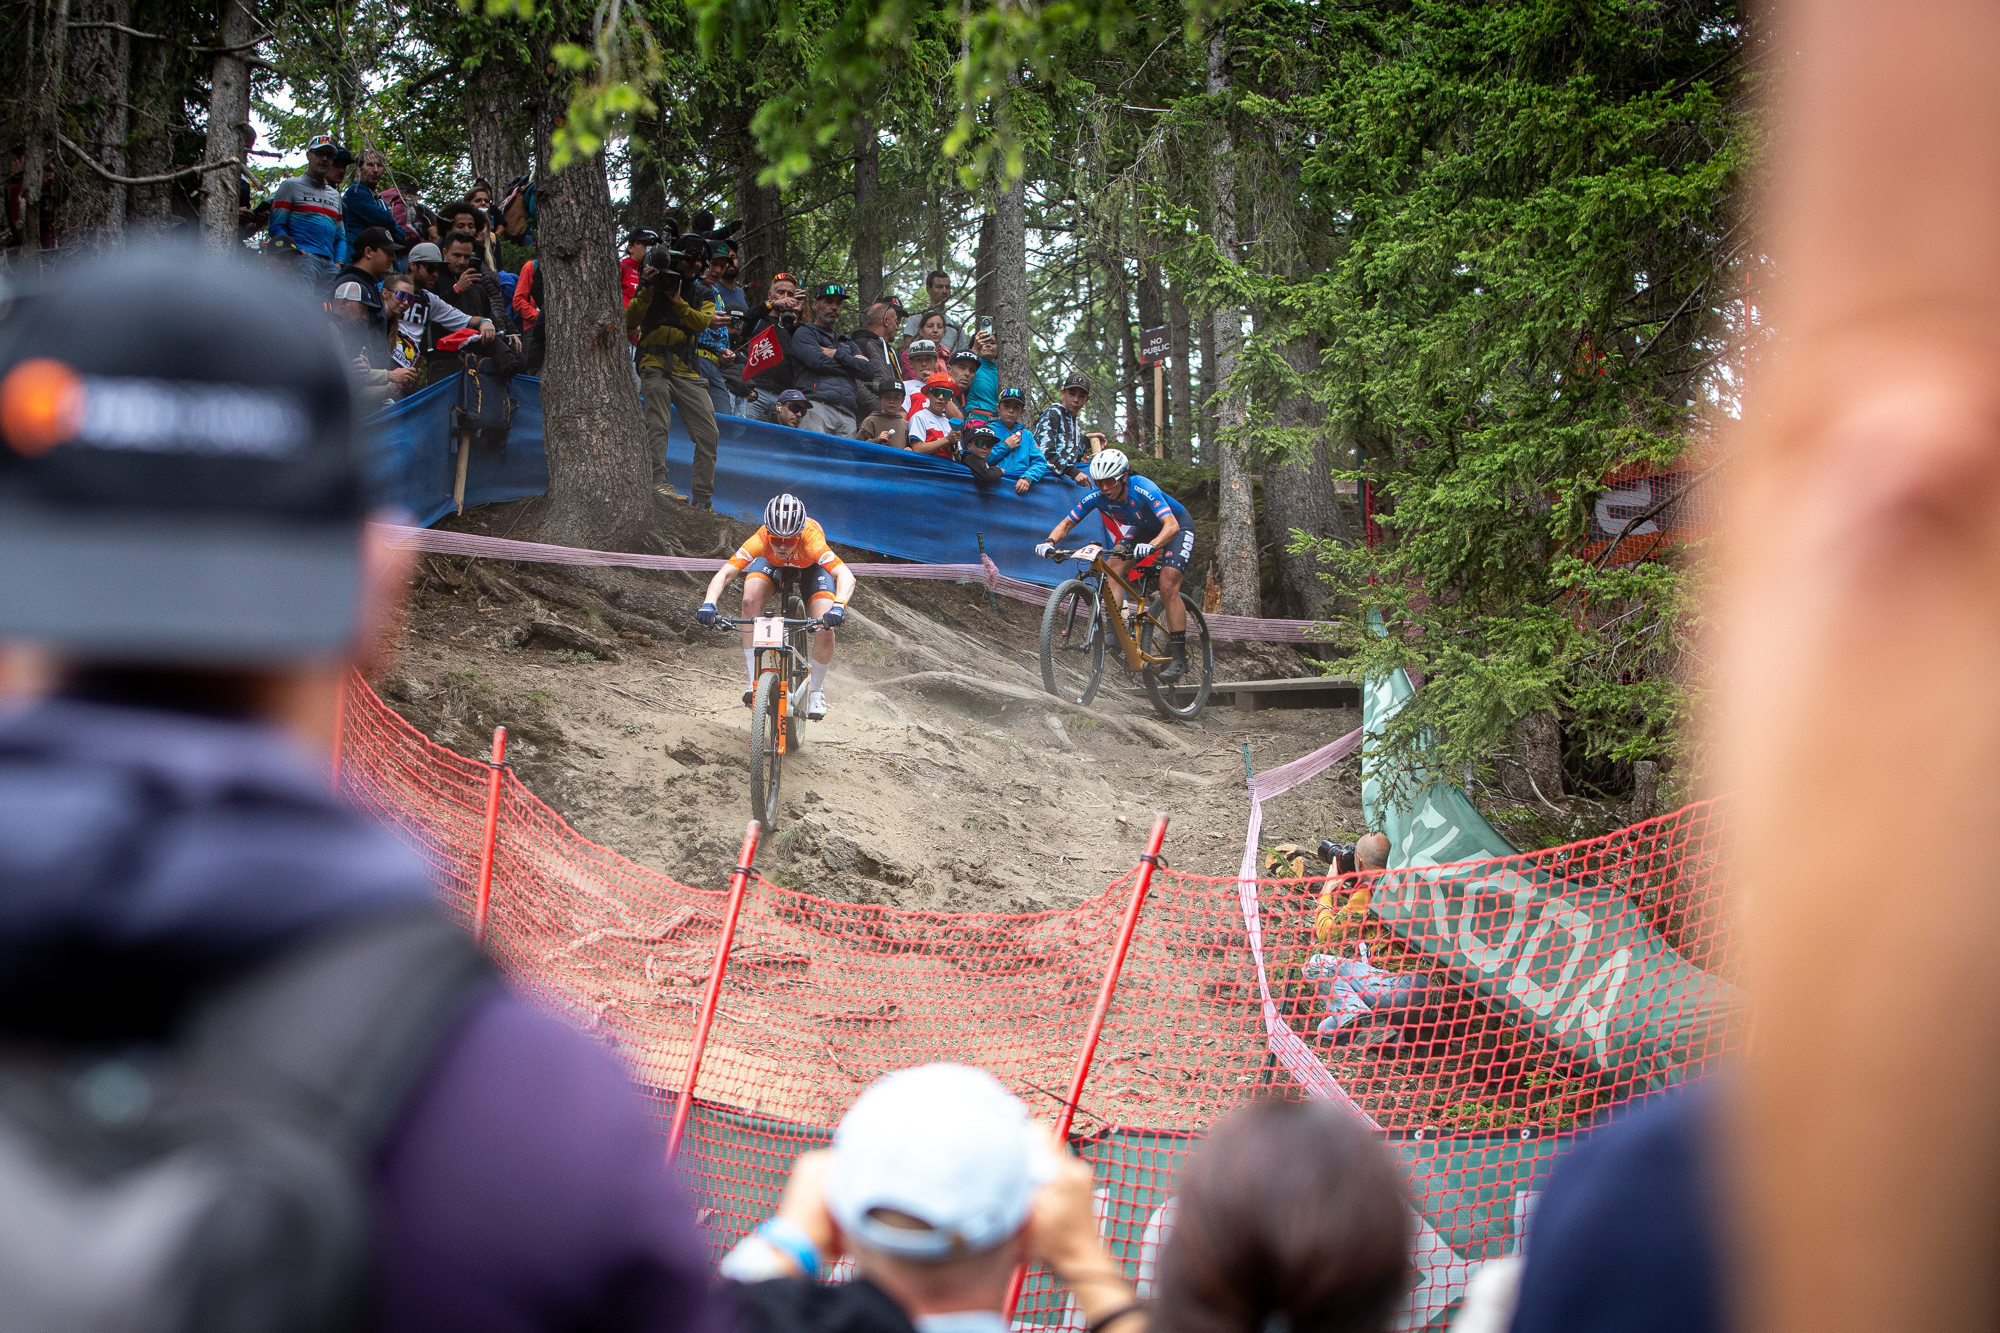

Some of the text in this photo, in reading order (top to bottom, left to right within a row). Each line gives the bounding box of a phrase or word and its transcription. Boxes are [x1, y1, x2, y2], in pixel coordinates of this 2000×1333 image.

[1150, 337, 1162, 346] NO
[1142, 343, 1170, 356] PUBLIC
[765, 624, 772, 638] 1
